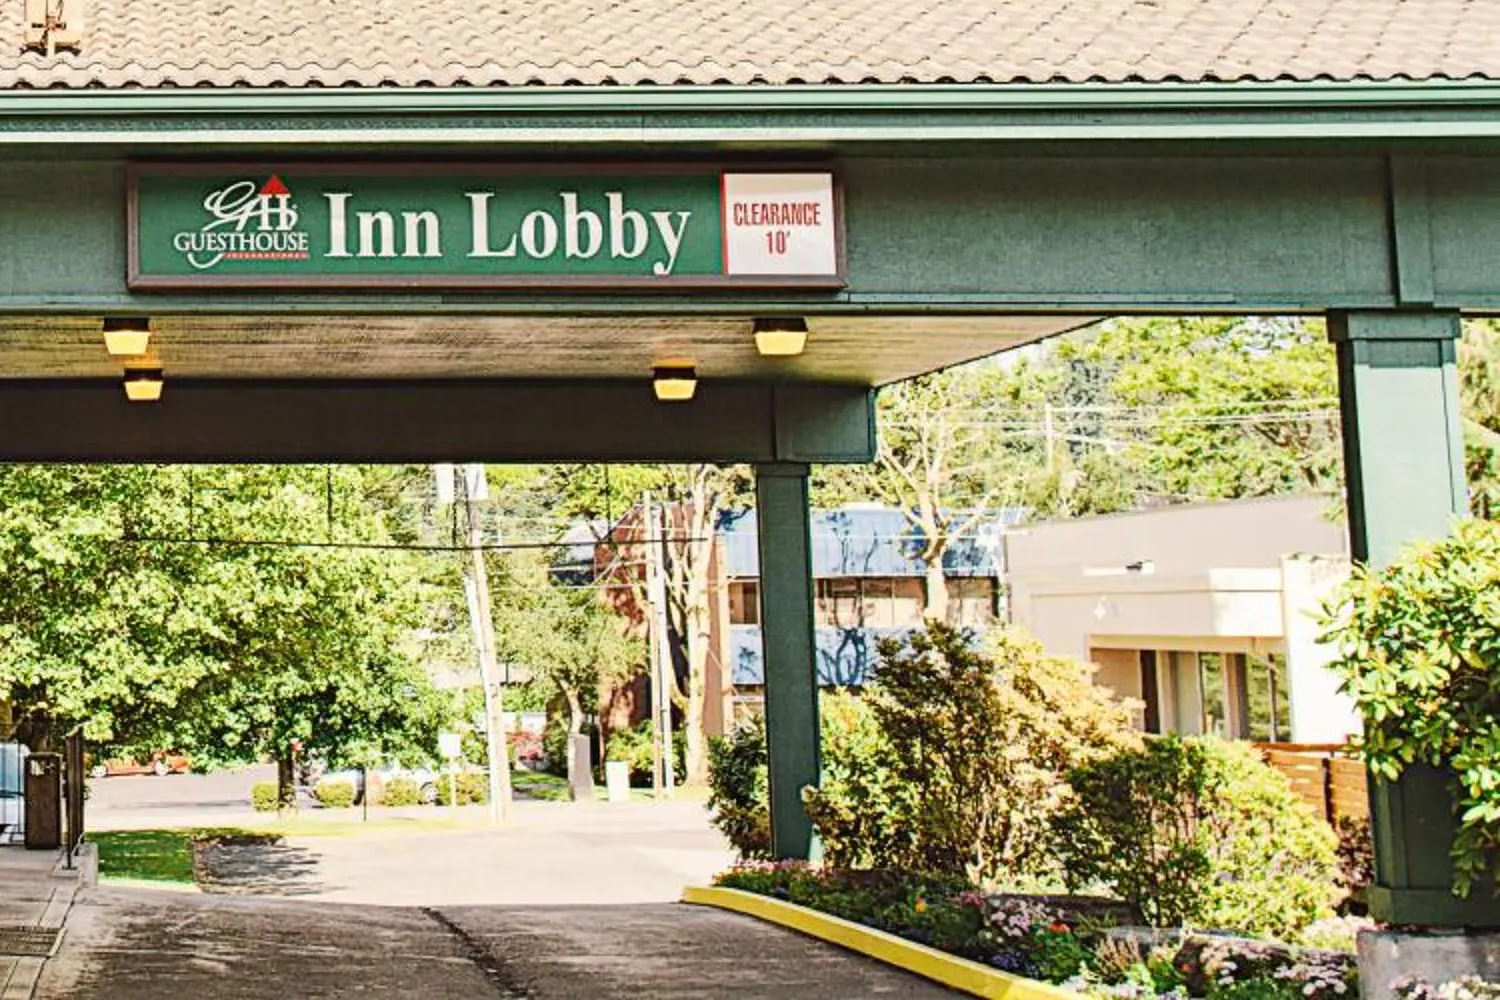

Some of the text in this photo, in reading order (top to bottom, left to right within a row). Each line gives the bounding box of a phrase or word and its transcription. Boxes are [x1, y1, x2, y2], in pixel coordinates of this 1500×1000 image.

[733, 203, 821, 226] CLEARANCE
[173, 231, 309, 251] GUESTHOUSE
[323, 191, 693, 275] Inn Lobby
